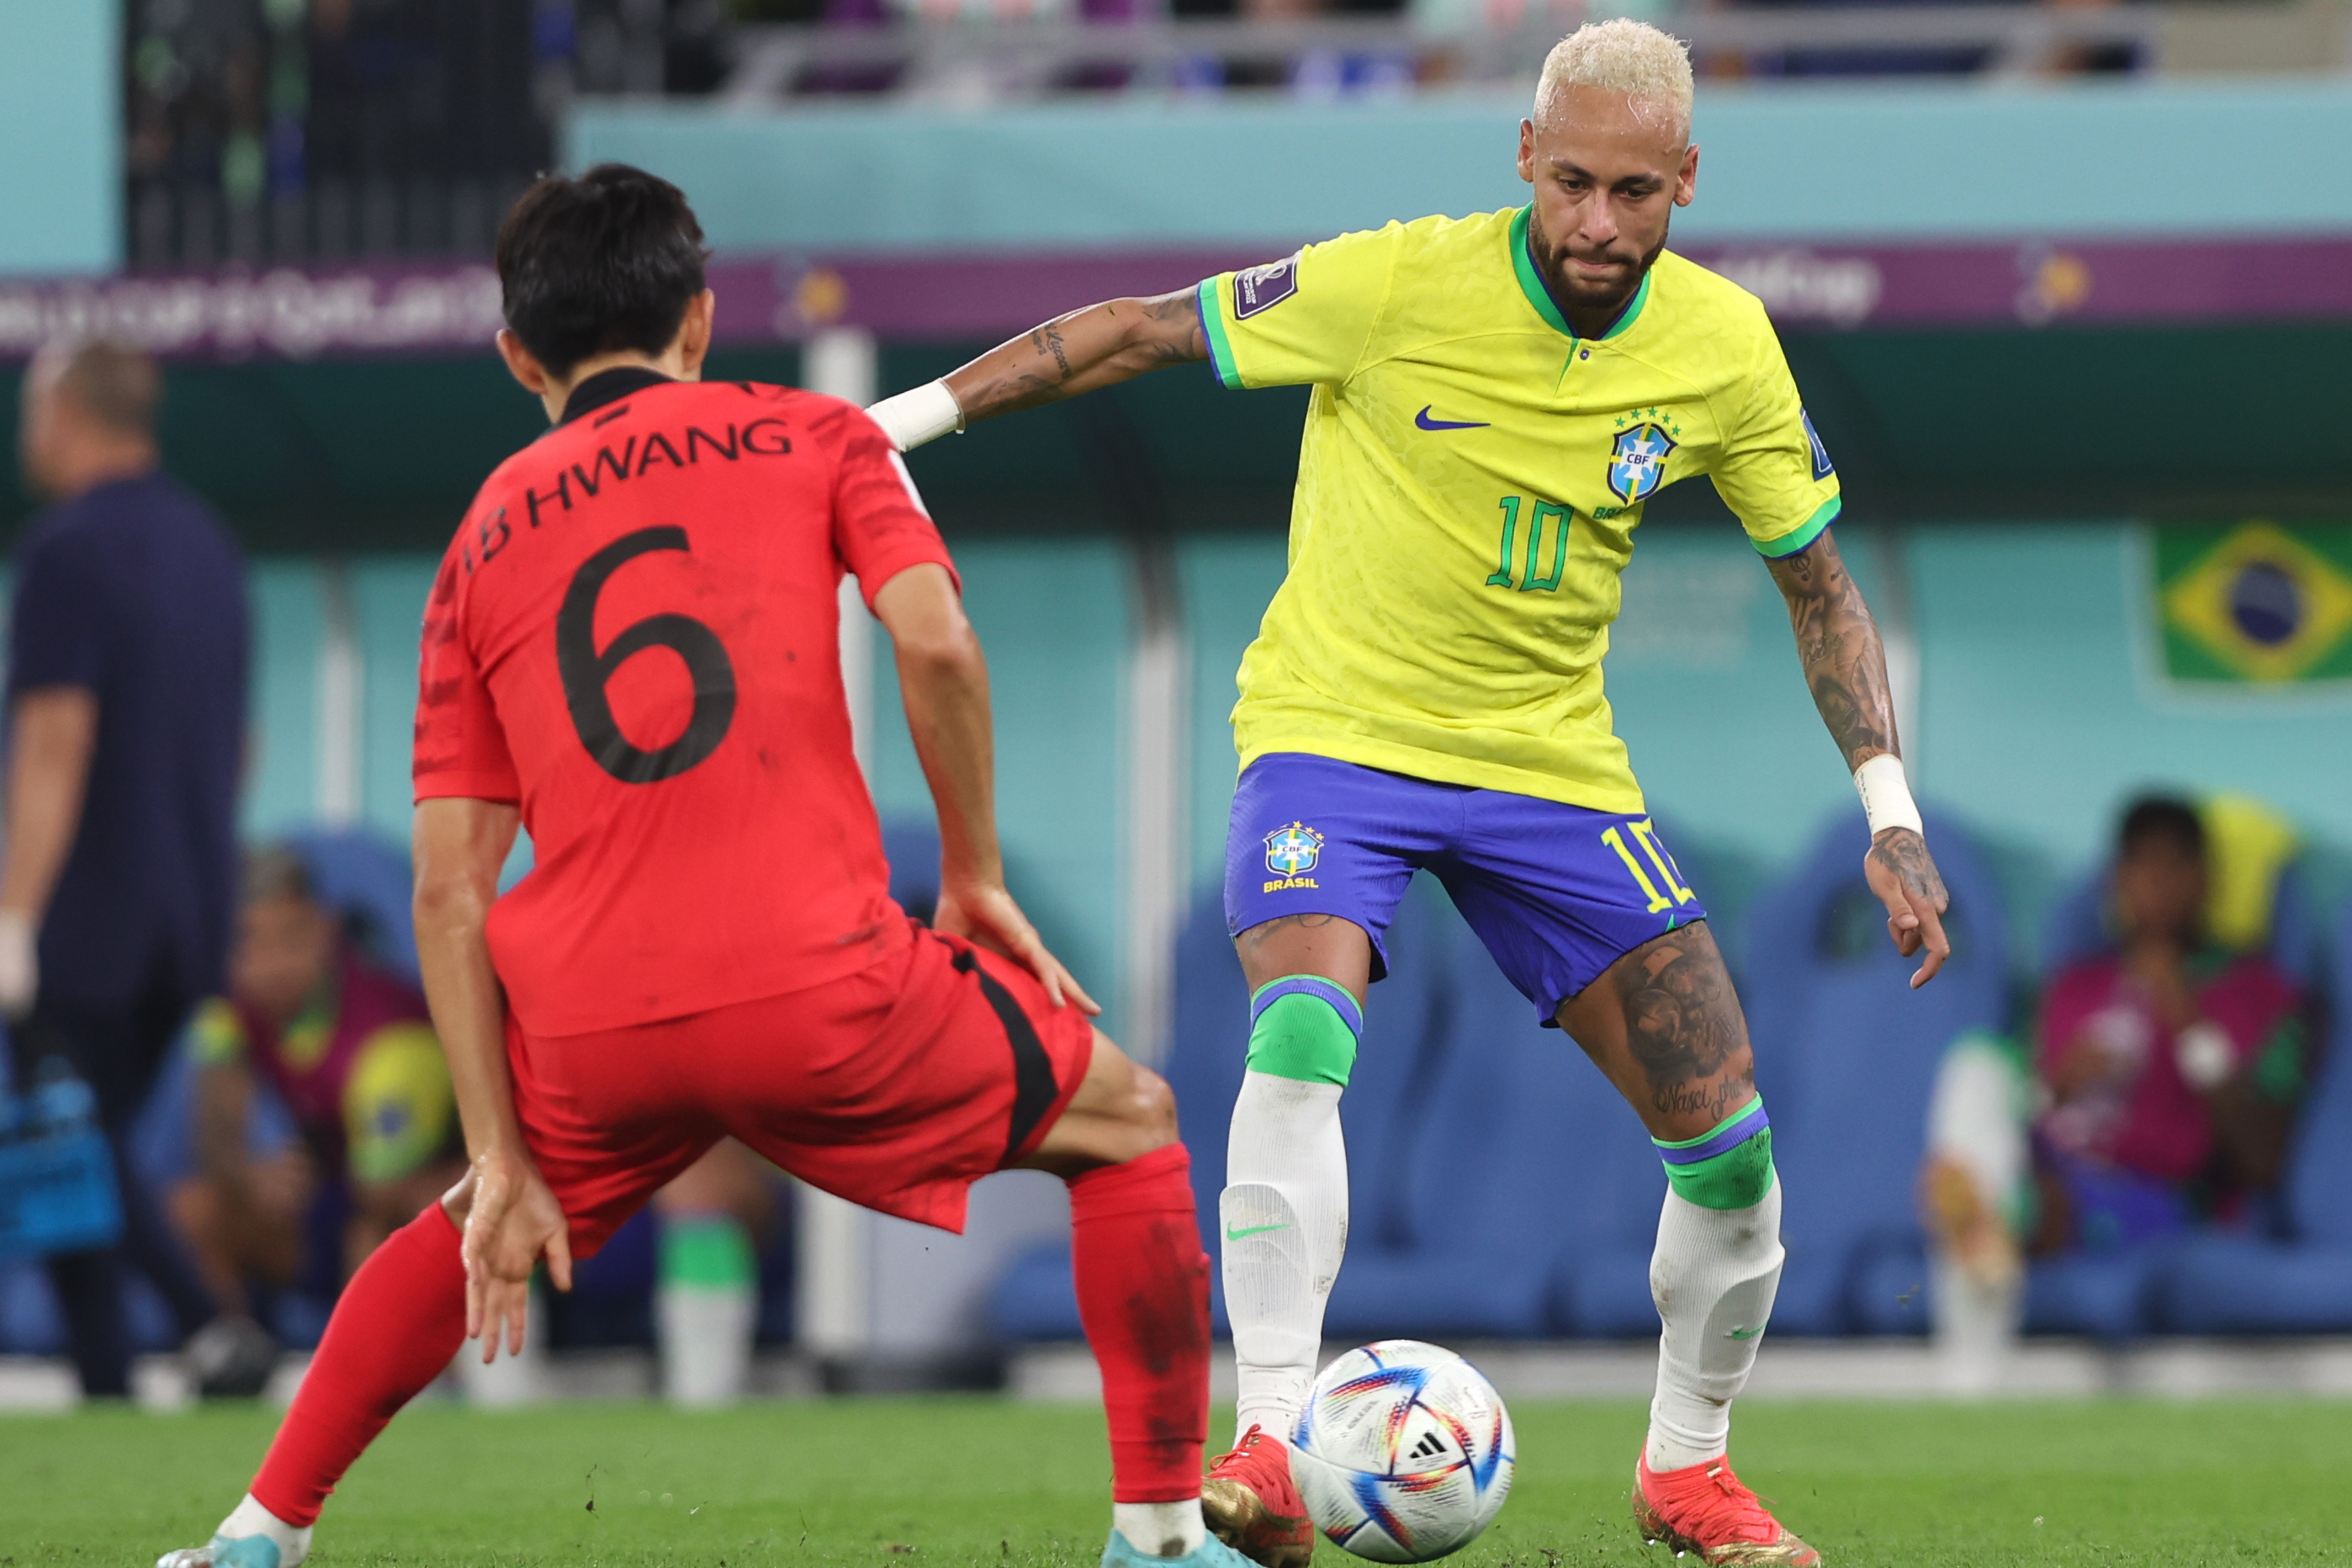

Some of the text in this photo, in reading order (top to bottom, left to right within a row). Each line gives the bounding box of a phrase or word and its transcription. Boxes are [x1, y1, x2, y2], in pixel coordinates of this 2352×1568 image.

[526, 417, 792, 529] HWANG
[1626, 453, 1650, 466] CBF
[1486, 495, 1575, 592] 10
[555, 524, 739, 785] 6
[1263, 877, 1320, 893] BRASIL
